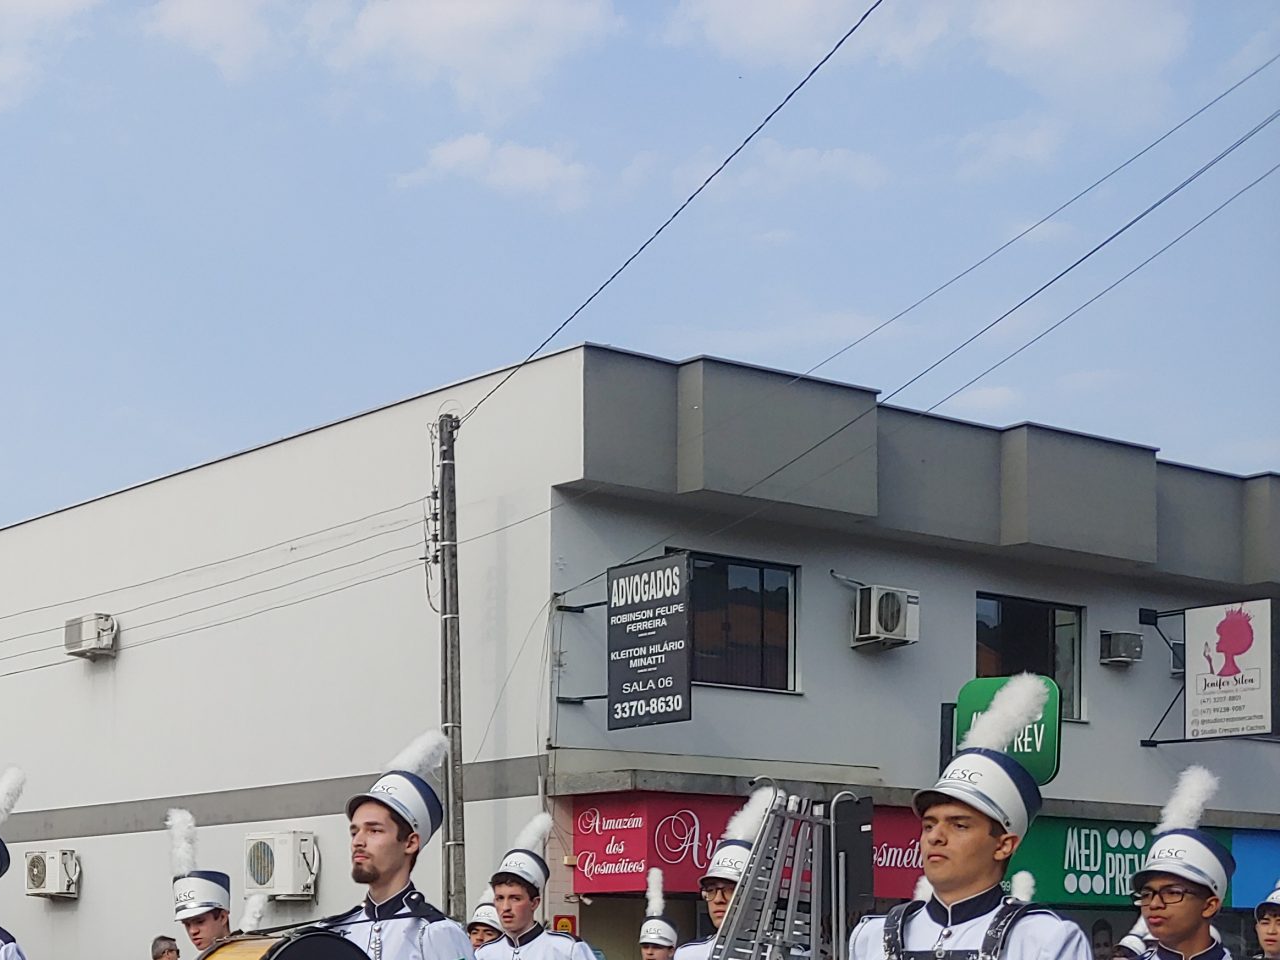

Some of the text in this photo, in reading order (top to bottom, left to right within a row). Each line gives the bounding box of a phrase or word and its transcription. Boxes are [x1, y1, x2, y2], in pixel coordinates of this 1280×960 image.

[611, 566, 680, 608] ADVOGADOS
[610, 603, 685, 625] ROBINSON FELIPE
[626, 617, 667, 633] FERREIRA
[610, 640, 685, 661] KLEITON HILÁRIO
[629, 654, 665, 668] MINATTI
[622, 676, 673, 694] SALA 06
[614, 694, 683, 719] 3370-8630
[1004, 723, 1044, 753] REV
[578, 807, 644, 835] Armazém
[605, 836, 625, 855] dos
[1064, 826, 1102, 872] MED
[576, 850, 646, 880] Cosméticos
